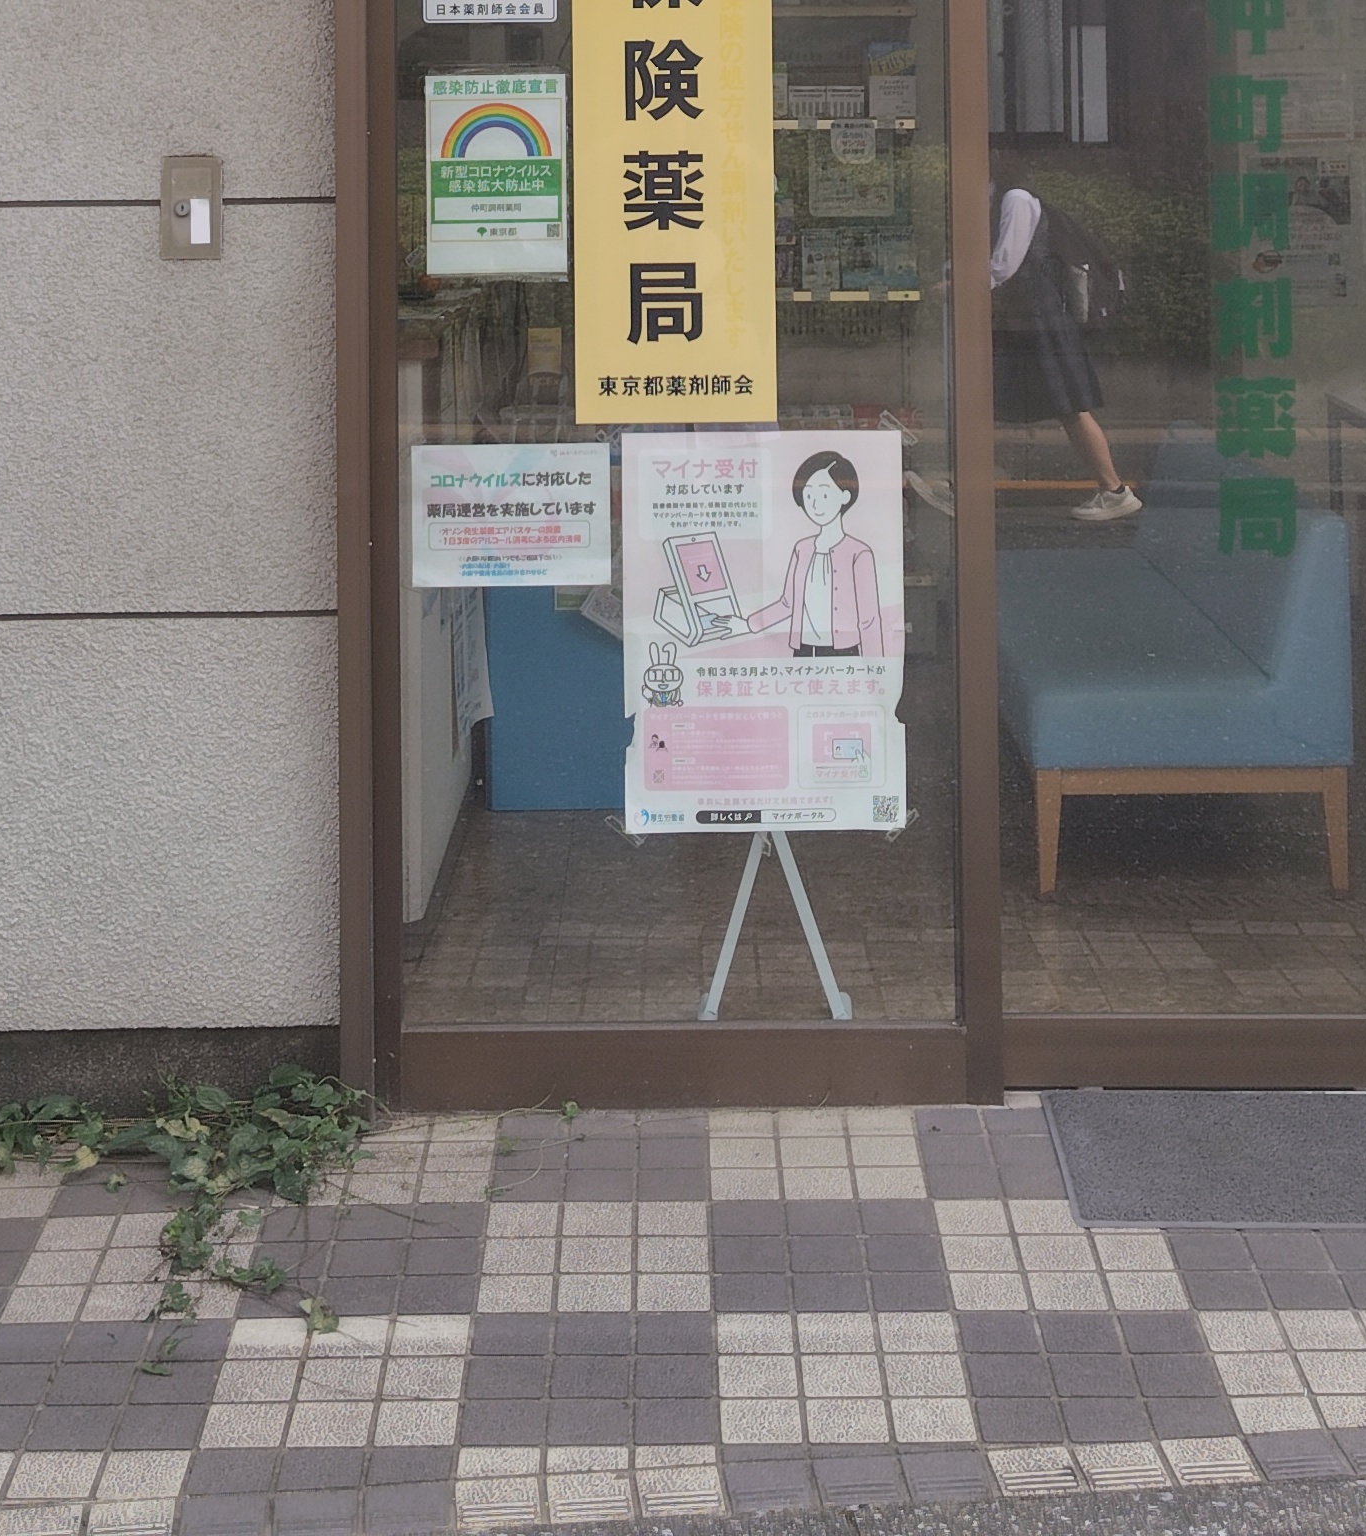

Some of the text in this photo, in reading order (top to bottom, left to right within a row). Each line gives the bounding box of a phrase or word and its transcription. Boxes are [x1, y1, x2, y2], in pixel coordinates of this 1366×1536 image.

[436, 3, 544, 15] 日本薬剤師会会員
[432, 78, 559, 96] 感染防止徹底宣言
[440, 165, 552, 179] 新型コロナウイルス
[448, 179, 545, 193] 感染拡大防止中
[598, 375, 754, 396] 東京都薬剤師会
[652, 458, 759, 479] マイナ受付
[430, 471, 592, 488] コロナウイルスに対応した
[665, 484, 744, 495] 対応しています
[427, 501, 597, 518] 薬局運営を実施しています
[696, 680, 885, 697] 保険証として使えます。
